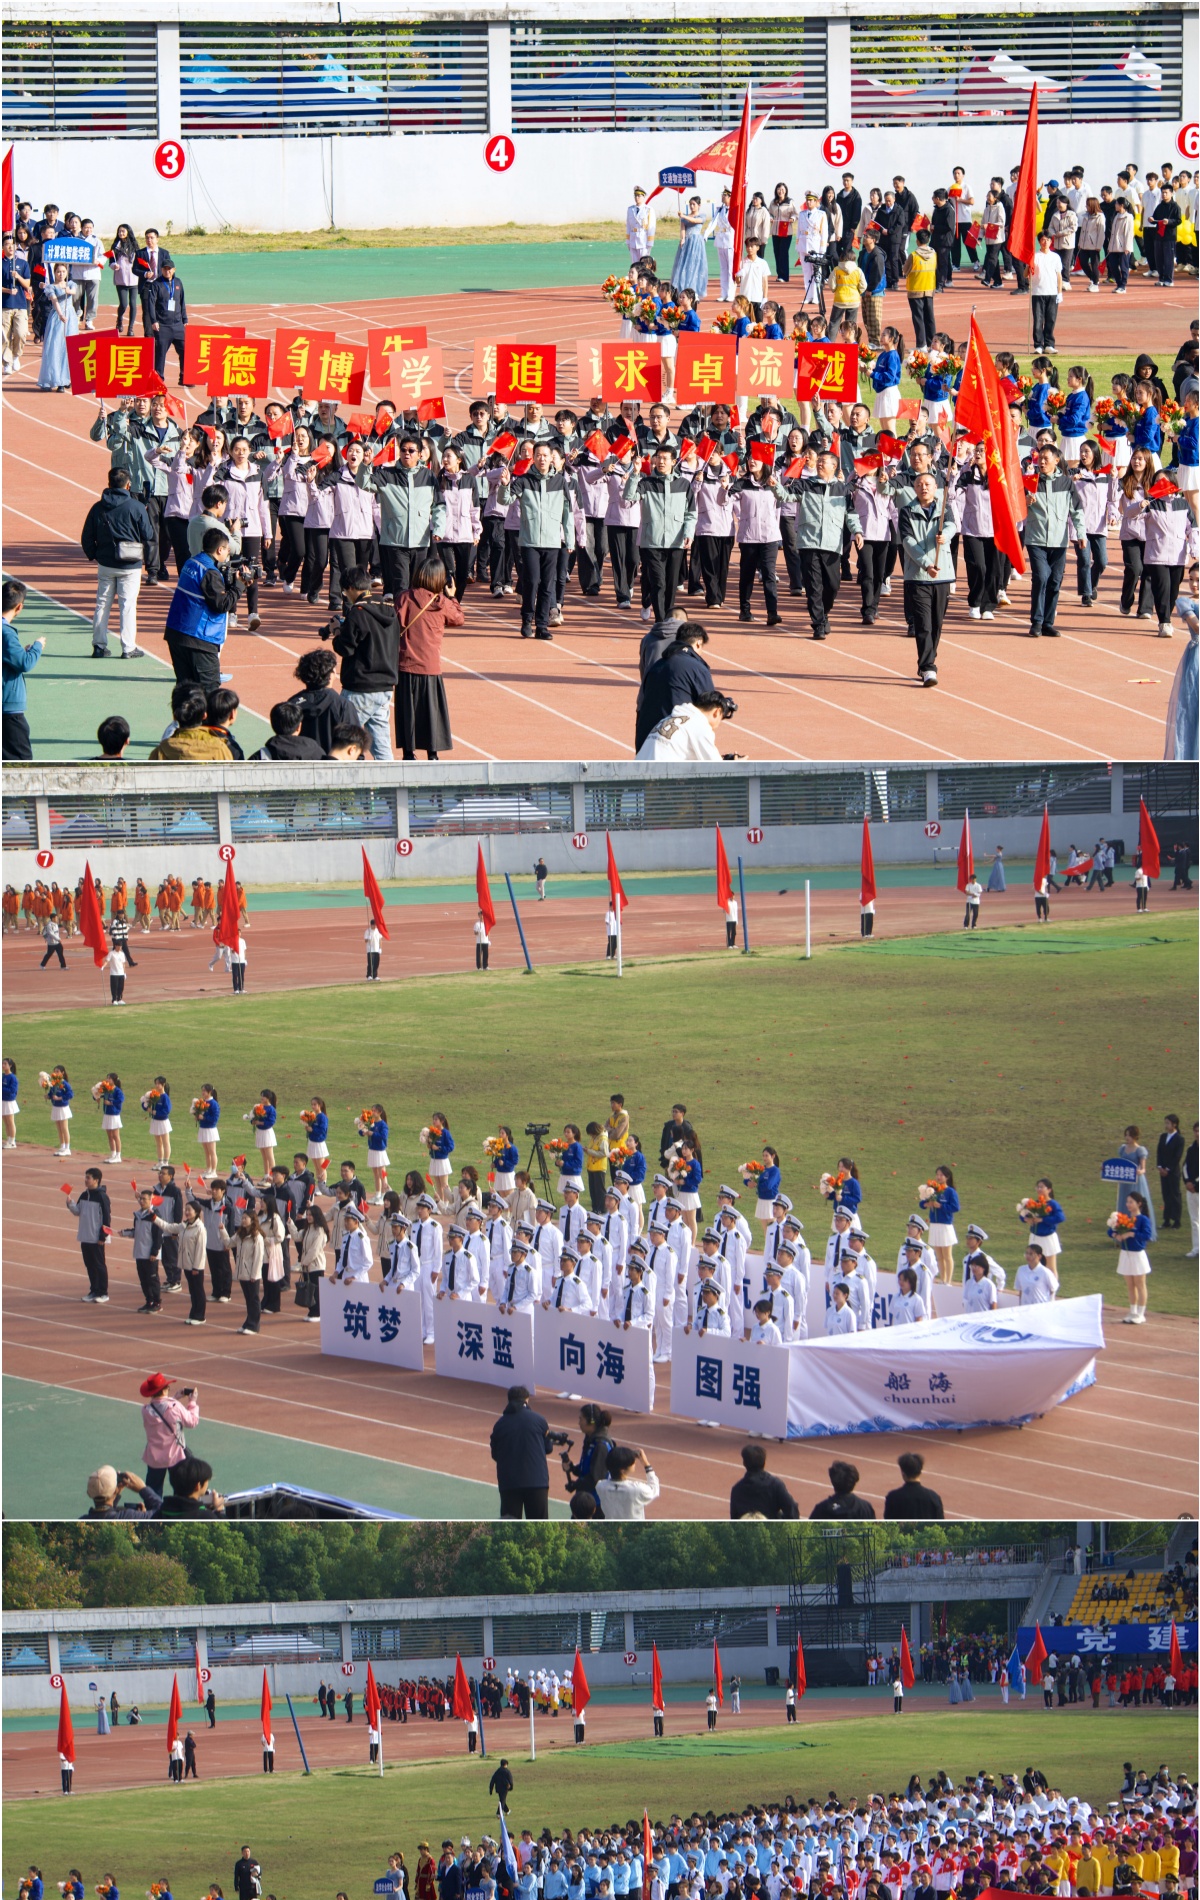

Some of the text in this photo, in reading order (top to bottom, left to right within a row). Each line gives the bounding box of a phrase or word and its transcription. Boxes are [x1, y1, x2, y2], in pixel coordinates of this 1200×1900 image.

[489, 140, 509, 168] 4
[829, 135, 849, 164] 5
[160, 146, 180, 175] 3
[661, 172, 694, 185] 交通物流学院
[47, 243, 91, 262] 计算机智能学院
[749, 830, 761, 842] 11
[925, 824, 939, 836] 12
[400, 841, 410, 854] 9
[573, 835, 588, 848] 10
[42, 853, 50, 867] 7
[222, 846, 232, 860] 8
[1103, 1163, 1136, 1180] 安全应急学院
[343, 1300, 403, 1343] 筑梦
[456, 1320, 515, 1369] 深蓝
[559, 1333, 625, 1385] 向海
[695, 1355, 762, 1410] 图强
[884, 1371, 953, 1393] 船海
[1076, 1626, 1189, 1653] 党建
[483, 1658, 494, 1670] 11
[624, 1653, 637, 1664] 12
[201, 1670, 209, 1681] 9
[342, 1663, 355, 1675] 10
[53, 1675, 62, 1687] 8
